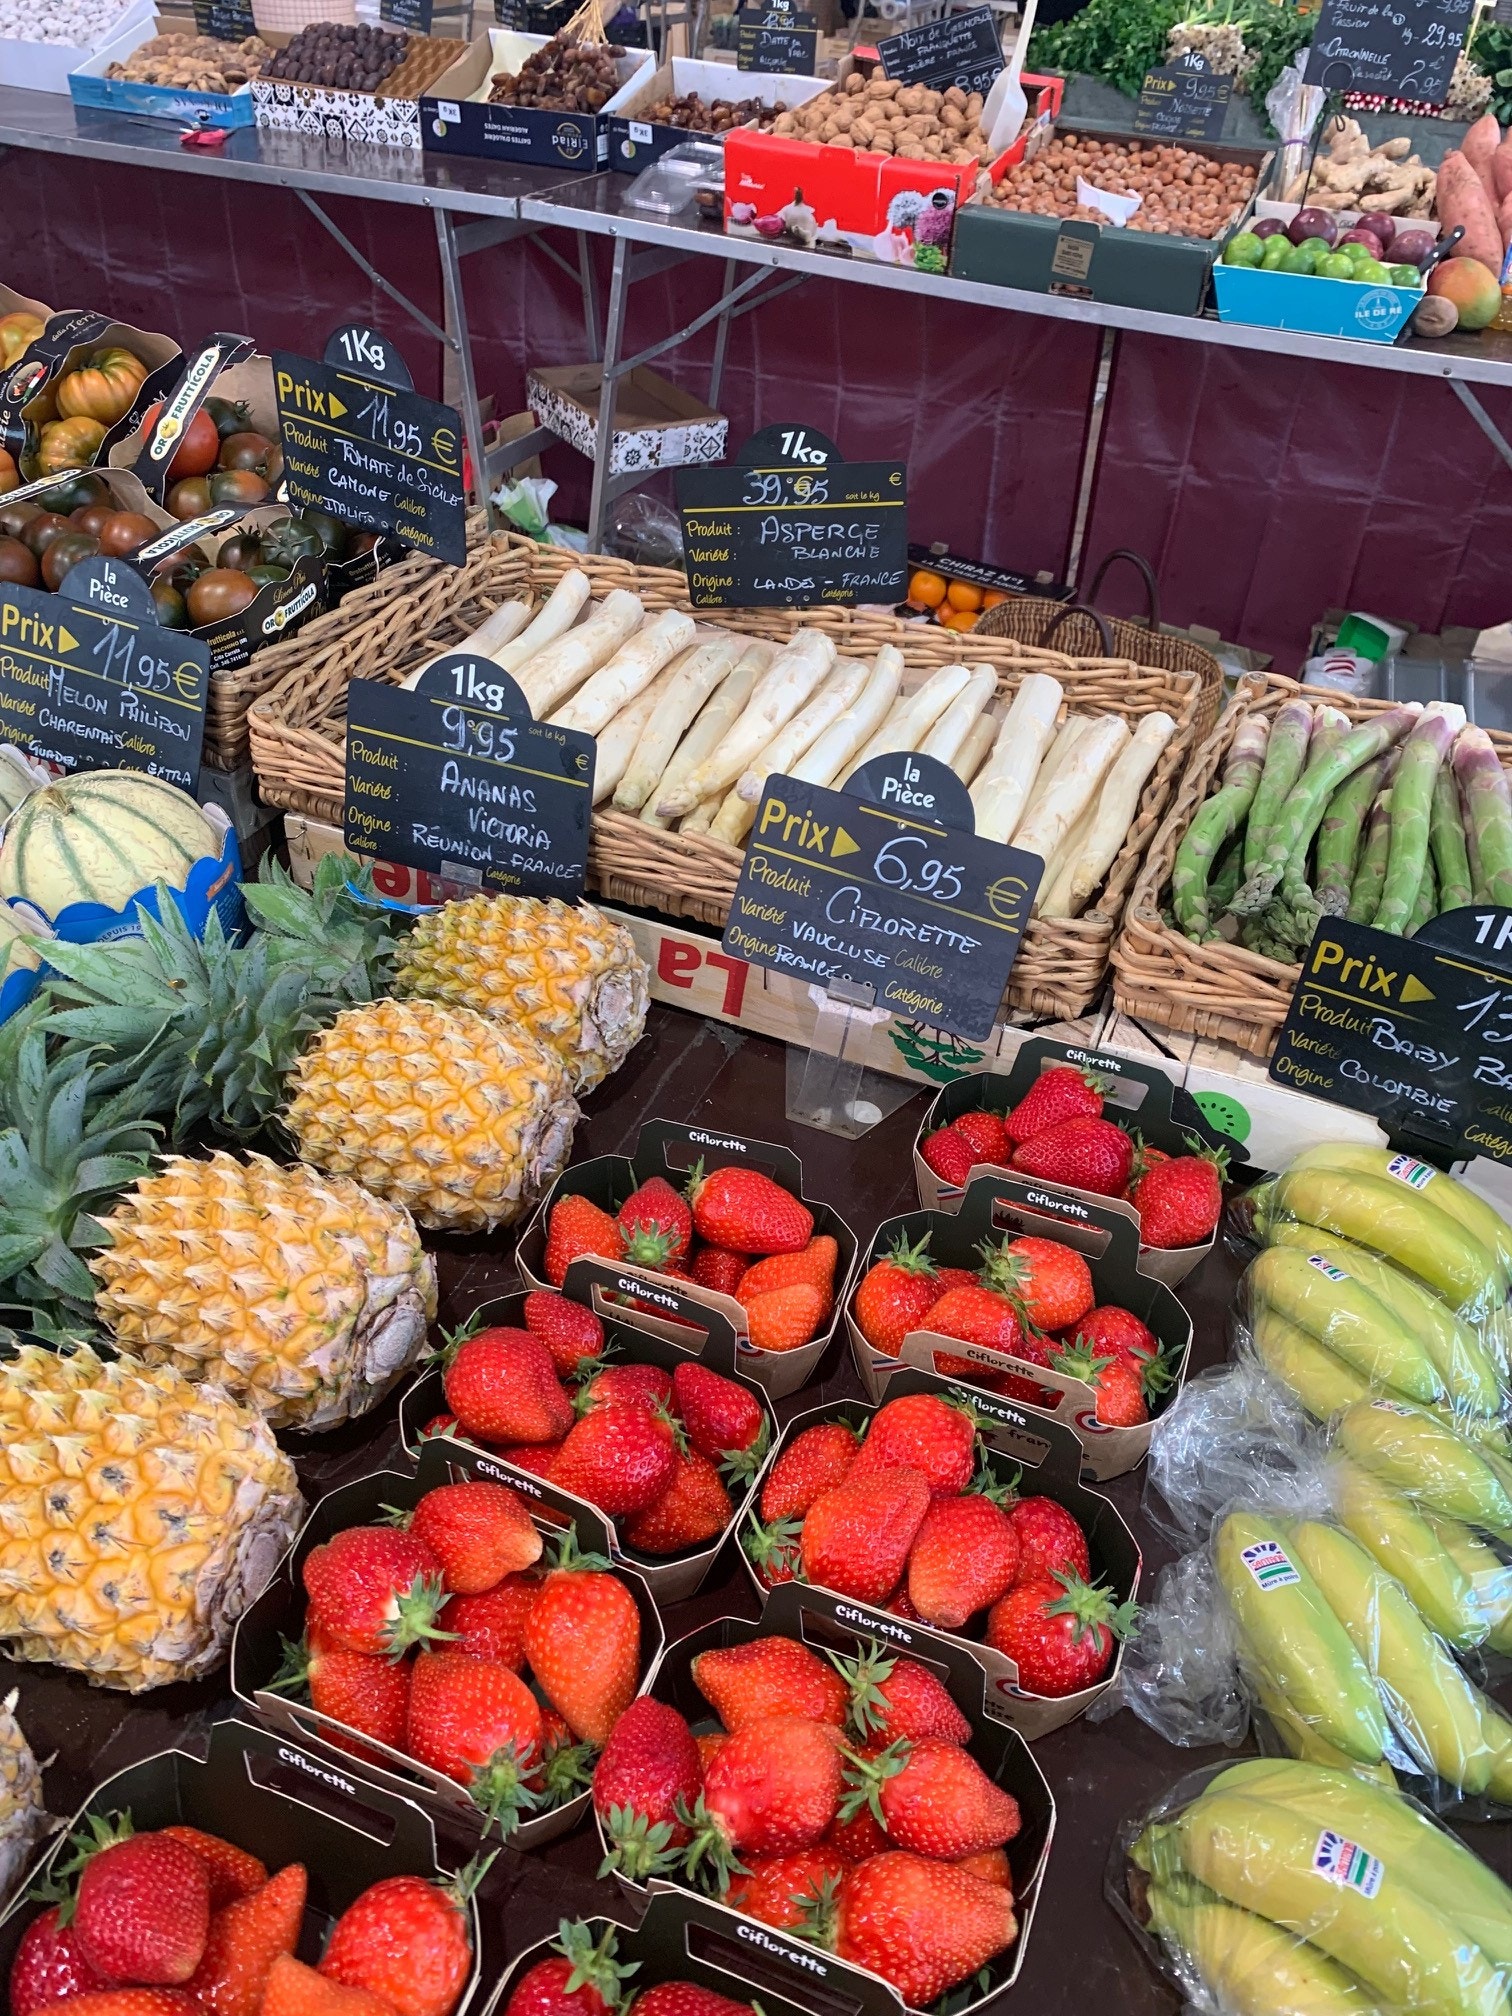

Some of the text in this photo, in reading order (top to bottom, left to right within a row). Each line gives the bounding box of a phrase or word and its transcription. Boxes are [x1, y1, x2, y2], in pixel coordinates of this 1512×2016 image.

[771, 0, 790, 11] 1kg
[929, 28, 940, 41] de
[1421, 23, 1464, 49] 29,95
[1183, 54, 1205, 71] 1Kg
[1326, 37, 1391, 65] CITRONNELLE
[1144, 74, 1230, 100] Prix 9,95 €
[65, 311, 98, 333] Terr
[1373, 308, 1387, 317] DE
[339, 329, 386, 371] 1Kg
[171, 352, 215, 420] FRUTTICOLA
[277, 371, 457, 465] Prix 11,95 €
[282, 421, 329, 454] Produit
[333, 437, 395, 477] TOMATE
[398, 463, 415, 487] de
[286, 455, 391, 502] Variété CAMONE
[289, 480, 324, 507] Origine
[742, 472, 902, 507] 39,95 €
[845, 490, 880, 502] soit le kg
[395, 520, 436, 548] Catégorie
[686, 515, 881, 545] Produit ASPERGE
[689, 545, 881, 562] Variété BLANCHE
[939, 558, 997, 578] CHIRAZ
[104, 562, 117, 585] la
[692, 573, 733, 593] Origine
[754, 577, 816, 589] LANDES
[841, 570, 905, 588] FRANCE
[89, 578, 129, 609] Pièce
[284, 586, 315, 620] FRUTTICOLA
[695, 594, 725, 605] Calibre
[821, 588, 855, 601] Catégorie
[1, 603, 203, 699] Prix 11,95 €
[206, 629, 237, 646] frutticola
[48, 665, 108, 715] MELON
[119, 690, 191, 741] PHILIBON
[451, 663, 505, 712] 1kg
[39, 709, 124, 749] CHARENTAIS
[120, 730, 157, 756] Calibre
[442, 705, 519, 763] 9,95
[528, 726, 543, 737] soit
[553, 731, 566, 745] kg
[147, 762, 192, 786] EXTRA
[351, 740, 537, 813] Produit ANANAS
[575, 754, 590, 771] €
[903, 757, 921, 783] la
[881, 776, 936, 809] Pièce
[349, 775, 552, 851] Variété VICTORIA
[348, 805, 392, 834] Origine
[412, 823, 493, 861] RÉUNION
[348, 833, 378, 851] Calibre
[758, 798, 1029, 920] Prix 6,95 €
[485, 866, 522, 886] Catégorie
[749, 856, 983, 955] Produit CIFLORETTE
[738, 896, 891, 968] Variété VAUCLUSE
[728, 925, 842, 980] Origine FRANCE
[893, 948, 943, 979] Calibre
[1311, 940, 1398, 997] Prix
[884, 980, 943, 1016] Catégorie
[1300, 993, 1374, 1036] Produit
[1371, 1018, 1461, 1072] BABY
[1066, 1049, 1122, 1072] Ciflorette
[1276, 1056, 1459, 1113] Origine COLOMBIE
[689, 1131, 747, 1153] Ciflorette
[1026, 1191, 1089, 1219] Ciflorette
[618, 1278, 679, 1310] Ciflorette
[966, 1349, 1034, 1378] Ciflorette
[1007, 1429, 1051, 1448] fran
[476, 1460, 542, 1498] Ciflorette
[835, 1604, 912, 1644] Ciflorette
[278, 1747, 356, 1795] Ciflorette
[736, 1924, 828, 1977] Ciflorette
